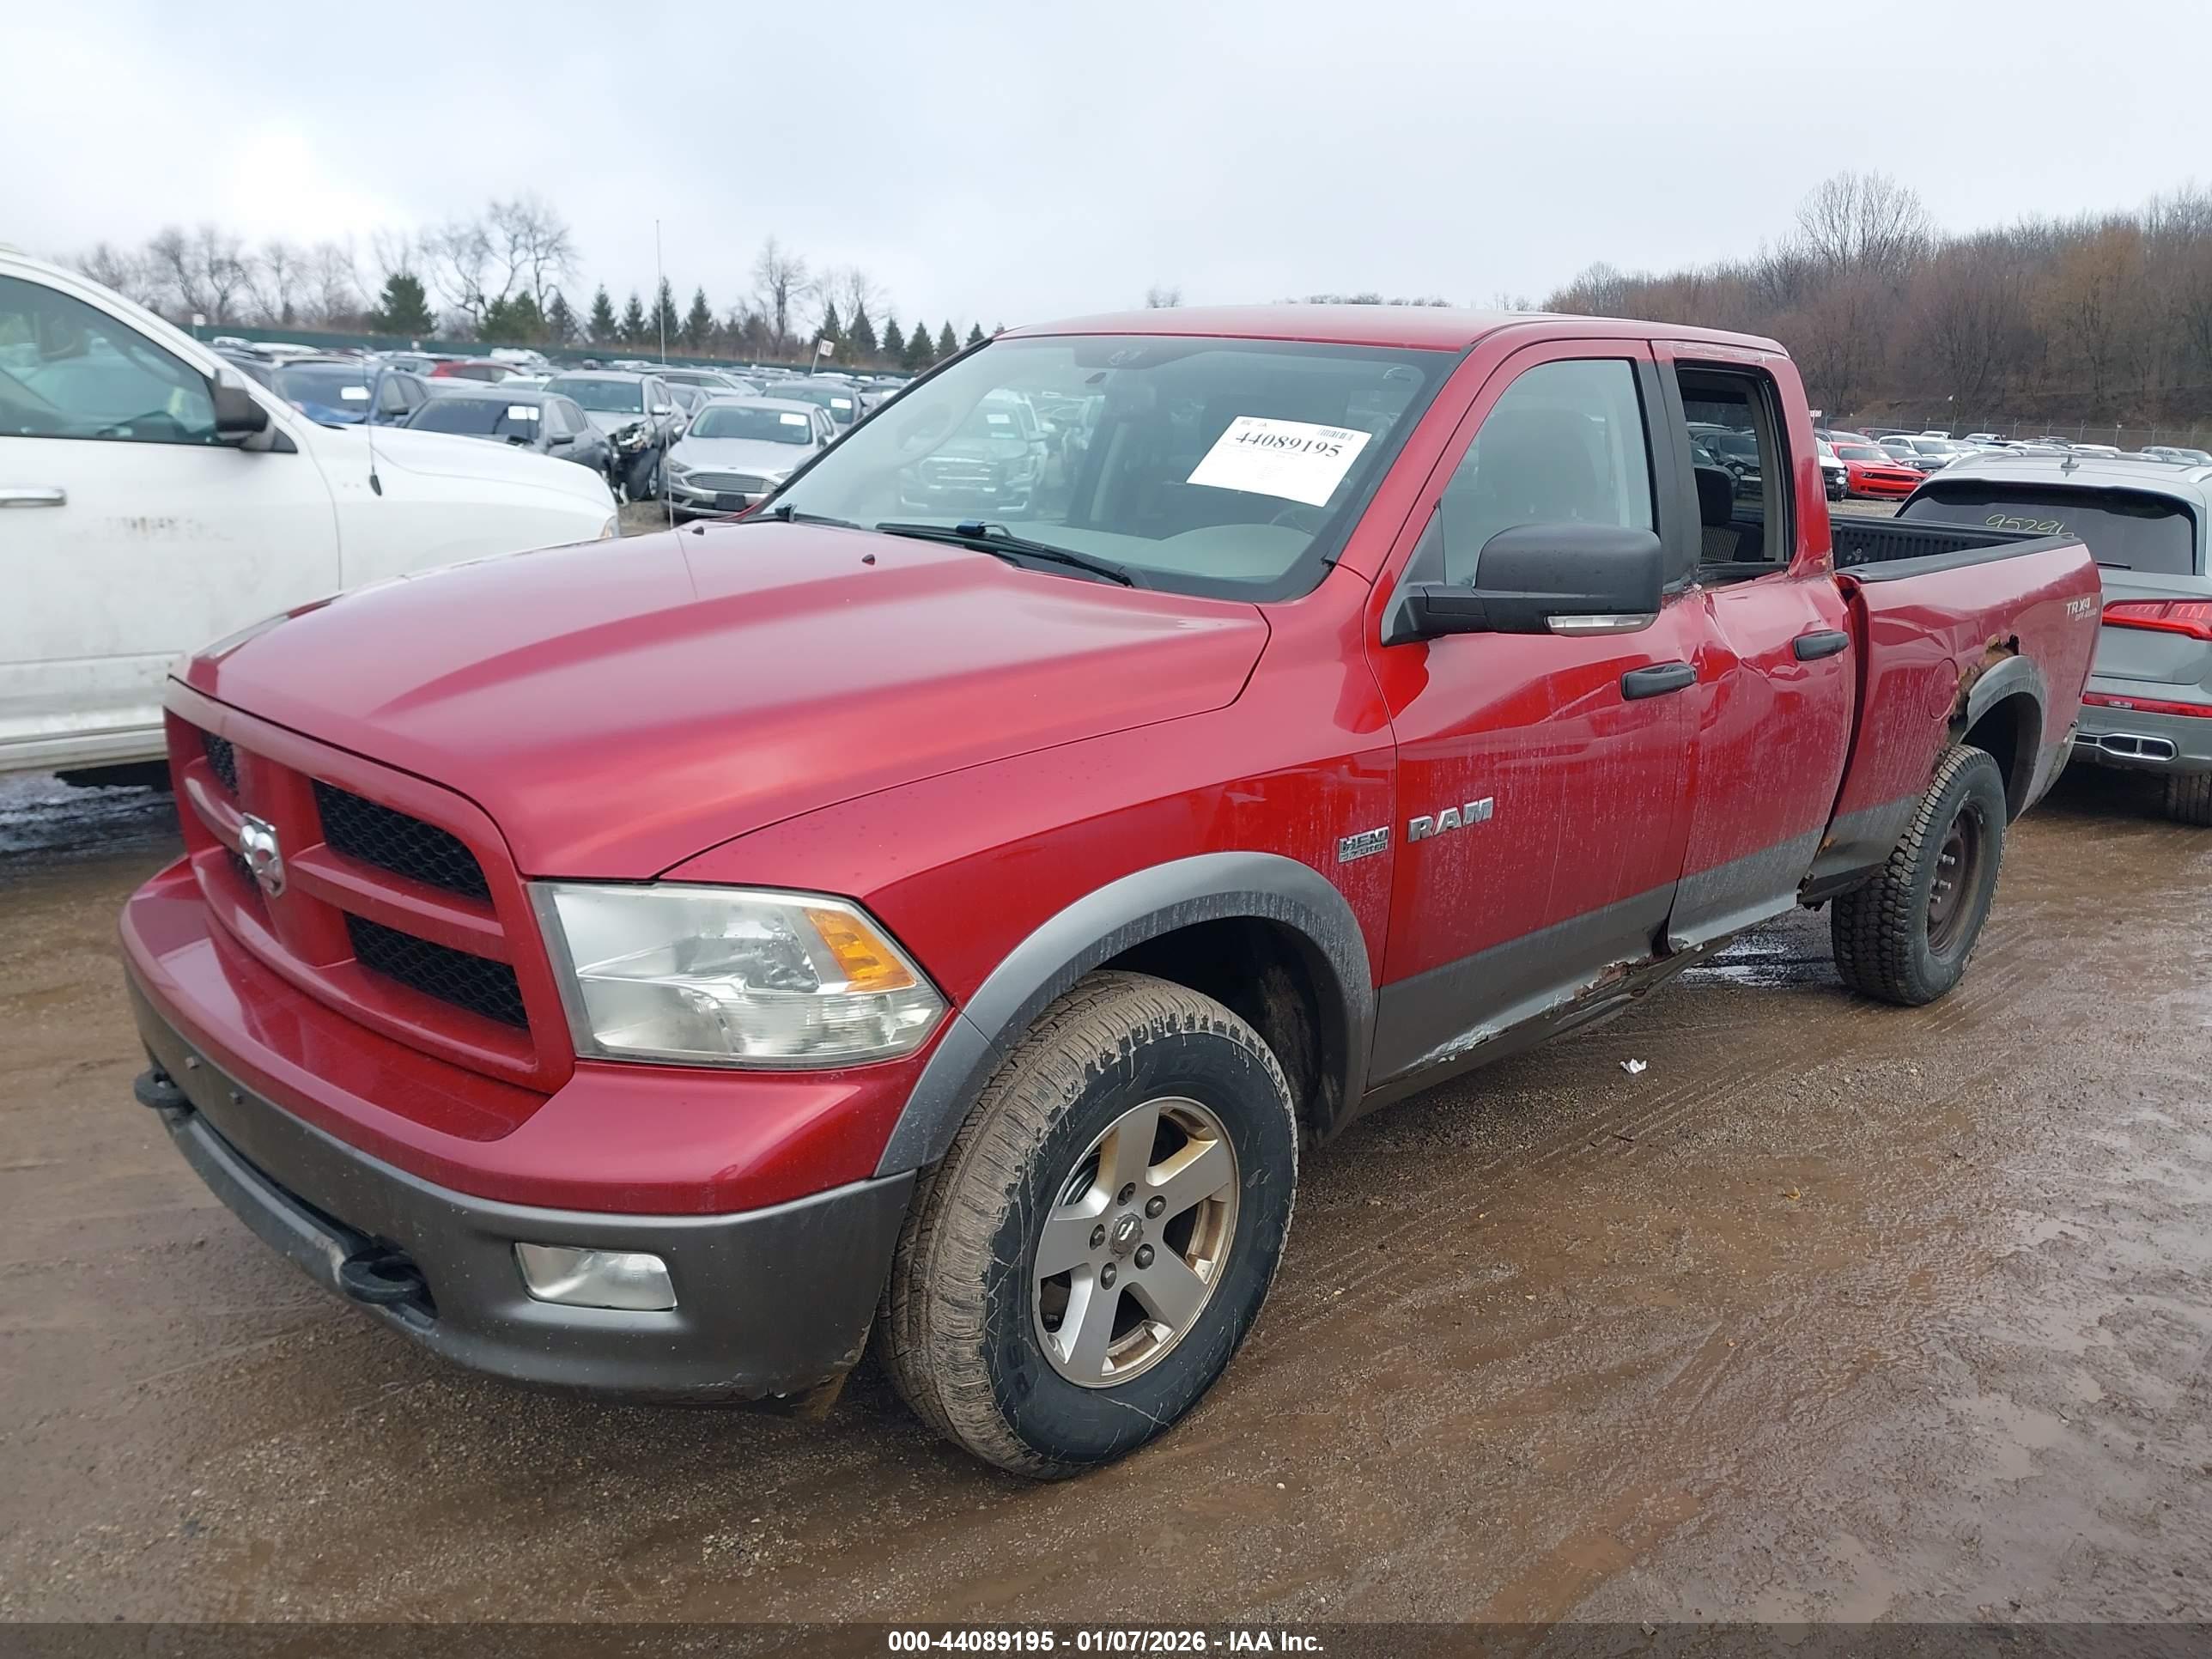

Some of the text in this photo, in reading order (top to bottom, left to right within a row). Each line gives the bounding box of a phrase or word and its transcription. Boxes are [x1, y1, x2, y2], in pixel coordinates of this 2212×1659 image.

[1235, 431, 1344, 458] 44089195
[2066, 597, 2091, 617] TRX4
[1407, 796, 1494, 843] RAM
[1339, 825, 1389, 854] HEMI
